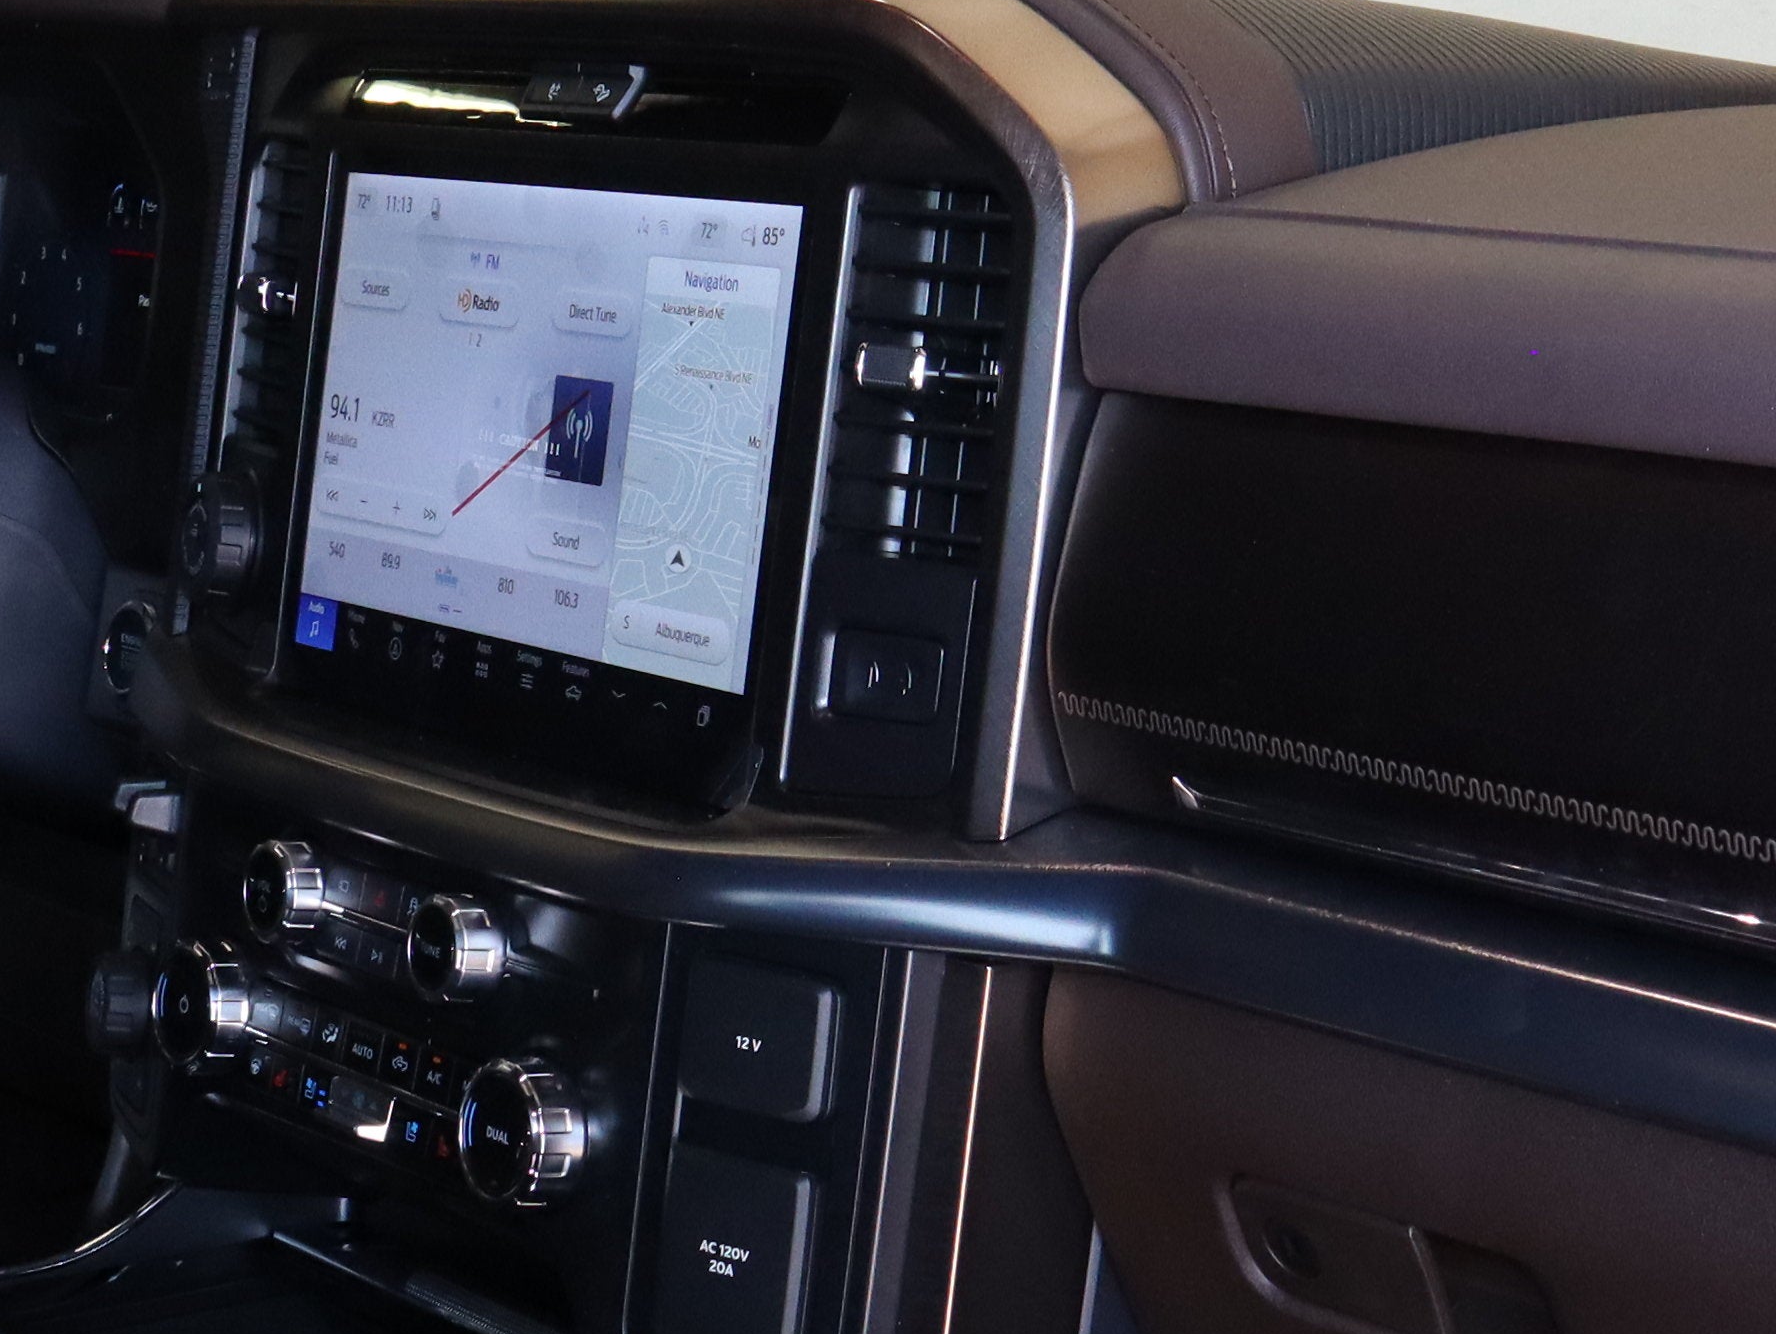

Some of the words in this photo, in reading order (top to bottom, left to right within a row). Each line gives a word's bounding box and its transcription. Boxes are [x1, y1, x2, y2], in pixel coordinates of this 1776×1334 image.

[386, 194, 413, 213] 11:13
[762, 226, 785, 246] 85°
[486, 254, 500, 270] FM
[362, 280, 390, 297] Sources
[684, 270, 739, 293] Navigation
[472, 293, 500, 312] Radio
[661, 302, 696, 317] Alexander
[697, 305, 714, 319] Blvd
[569, 303, 593, 321] Direct
[595, 306, 617, 324] Tune
[330, 393, 360, 422] 94.1
[326, 431, 358, 448] Metallica
[328, 540, 346, 558] 540
[552, 531, 580, 551] Sound
[498, 577, 514, 595] 810
[554, 588, 579, 609] 106.3
[655, 622, 711, 647] Albuquerque
[352, 1042, 375, 1061] AUTO
[735, 1035, 750, 1051] 12
[751, 1038, 762, 1053] V
[426, 1070, 443, 1086] A/C
[485, 1125, 510, 1146] DUAL
[699, 1239, 717, 1256] AC
[719, 1243, 750, 1263] 120V
[708, 1259, 735, 1278] 20A
